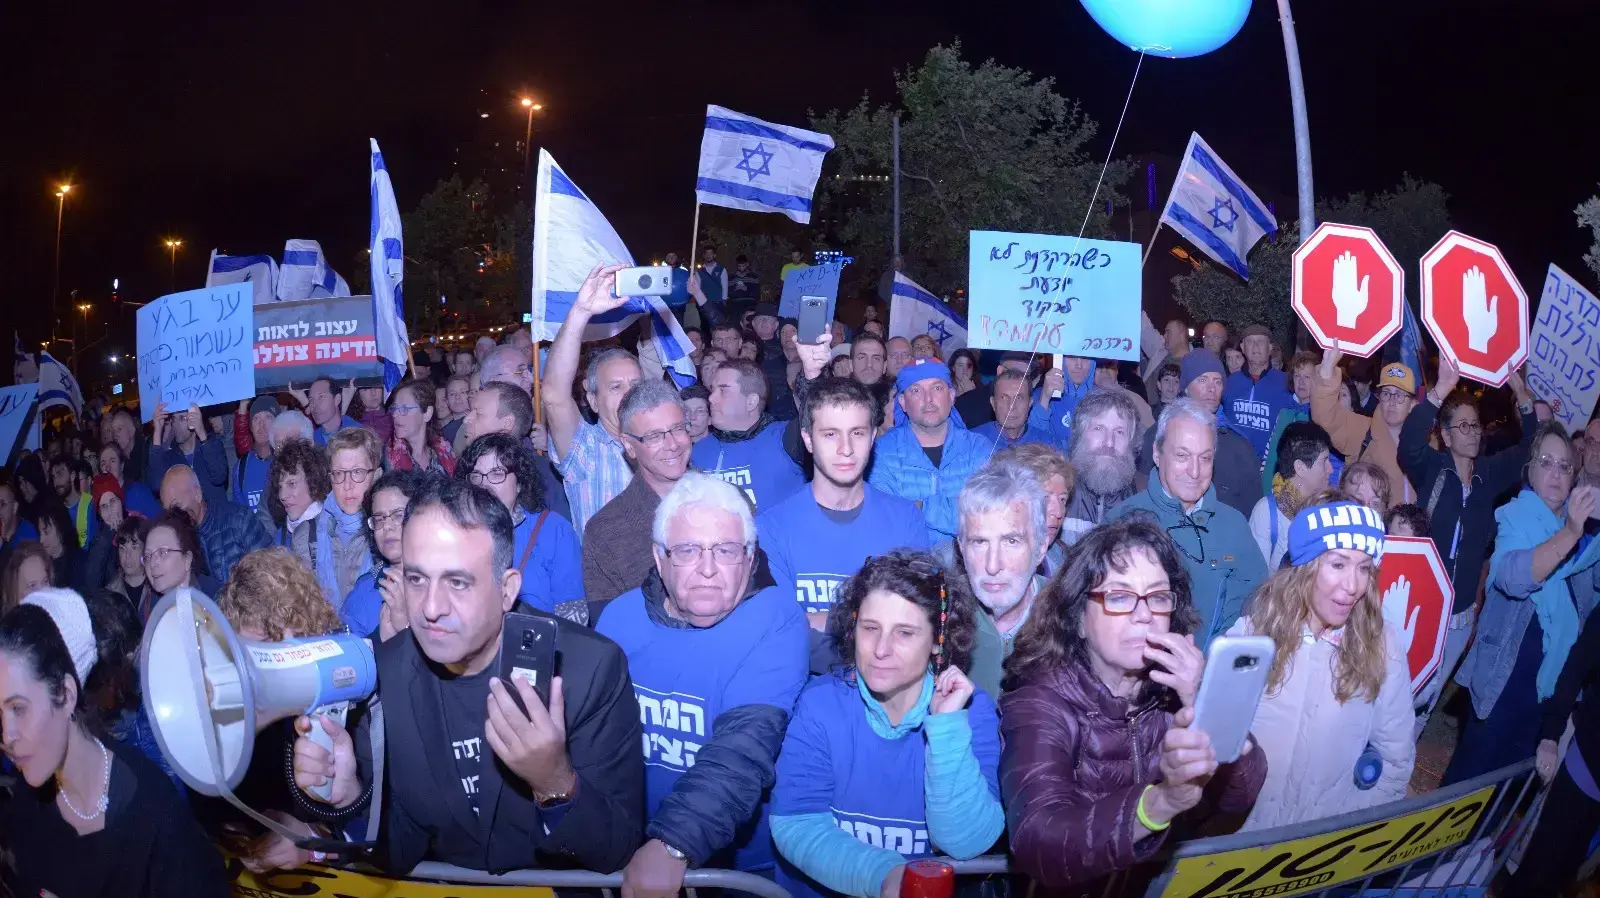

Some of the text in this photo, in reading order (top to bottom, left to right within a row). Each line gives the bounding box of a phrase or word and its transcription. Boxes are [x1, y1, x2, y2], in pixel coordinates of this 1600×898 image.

[989, 242, 1020, 261] לא
[211, 290, 241, 323] על
[258, 319, 358, 341] עצוב לראות
[315, 340, 377, 359] מדינה
[1534, 333, 1596, 392] לתהום
[1233, 401, 1270, 417] המחנה
[634, 692, 705, 737] המח
